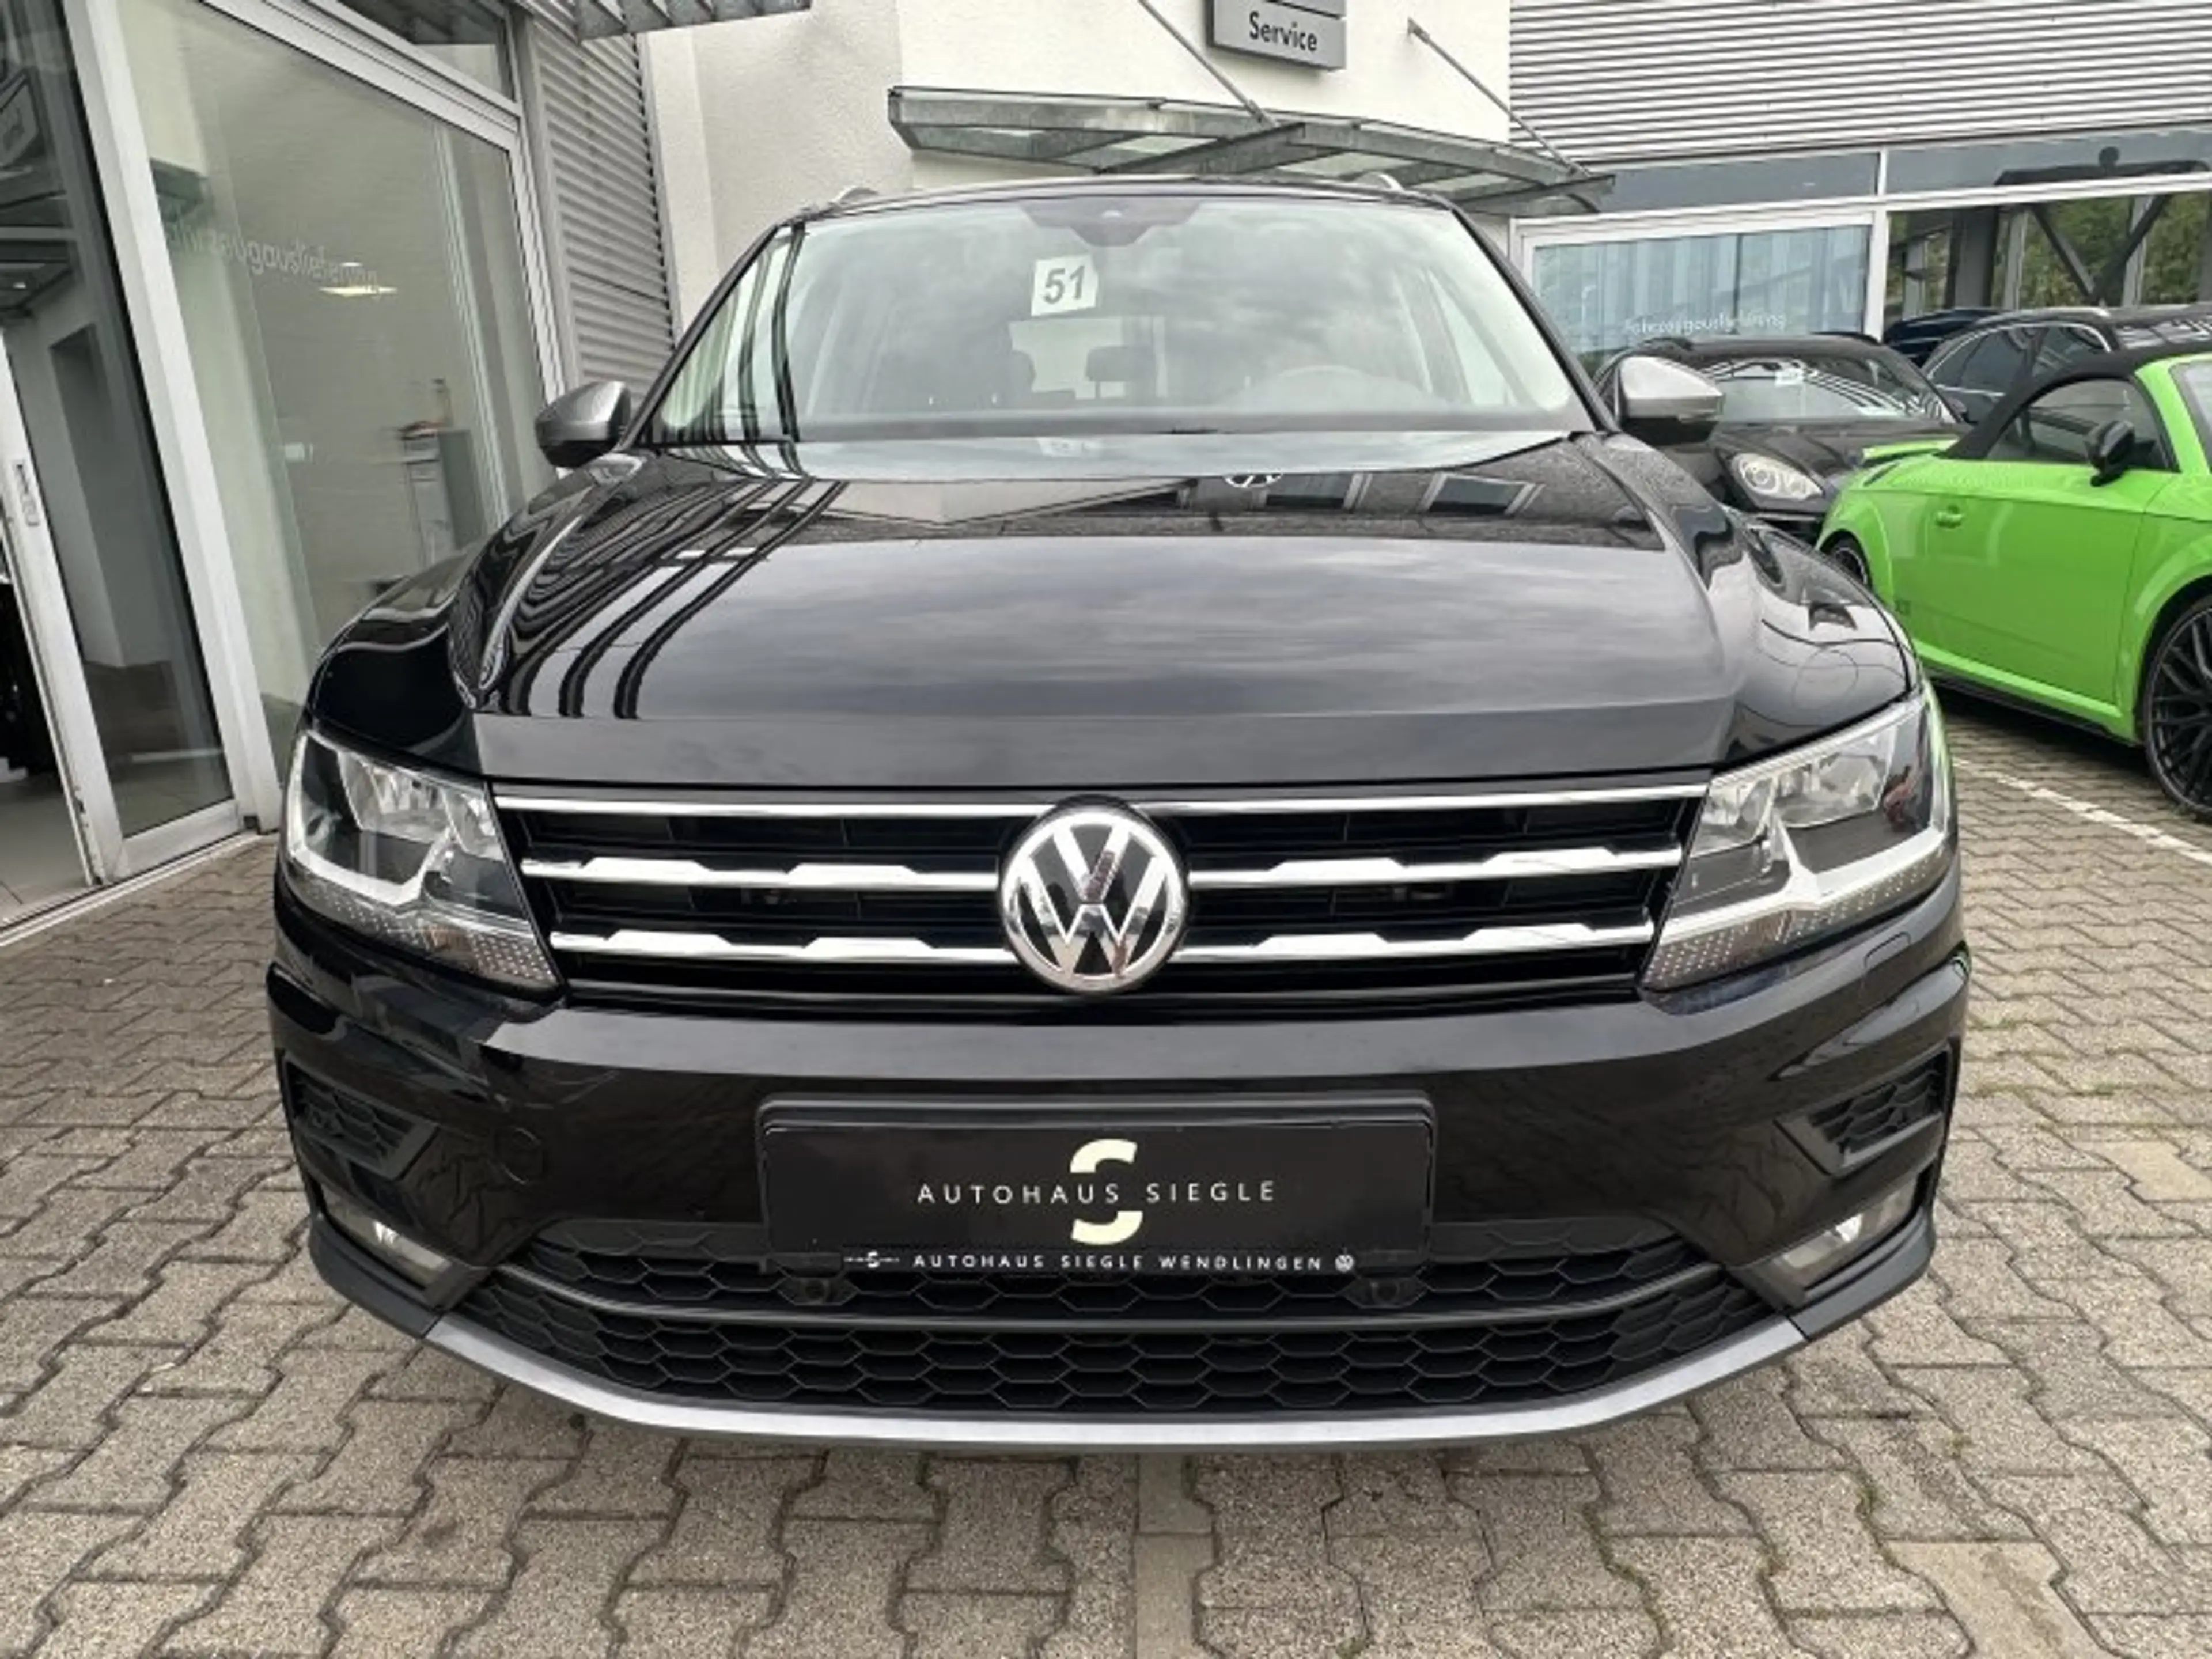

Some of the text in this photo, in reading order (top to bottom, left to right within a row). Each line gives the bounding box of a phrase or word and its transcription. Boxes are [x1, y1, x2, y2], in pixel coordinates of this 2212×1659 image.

[1249, 10, 1318, 51] Service
[1044, 265, 1085, 304] 51
[917, 1180, 1274, 1205] AUTOHAUS SIEGLE
[913, 1254, 1044, 1268] AUTOHAUS
[1061, 1254, 1142, 1269] SIEGLE
[1158, 1254, 1321, 1271] WENDLINGEN
